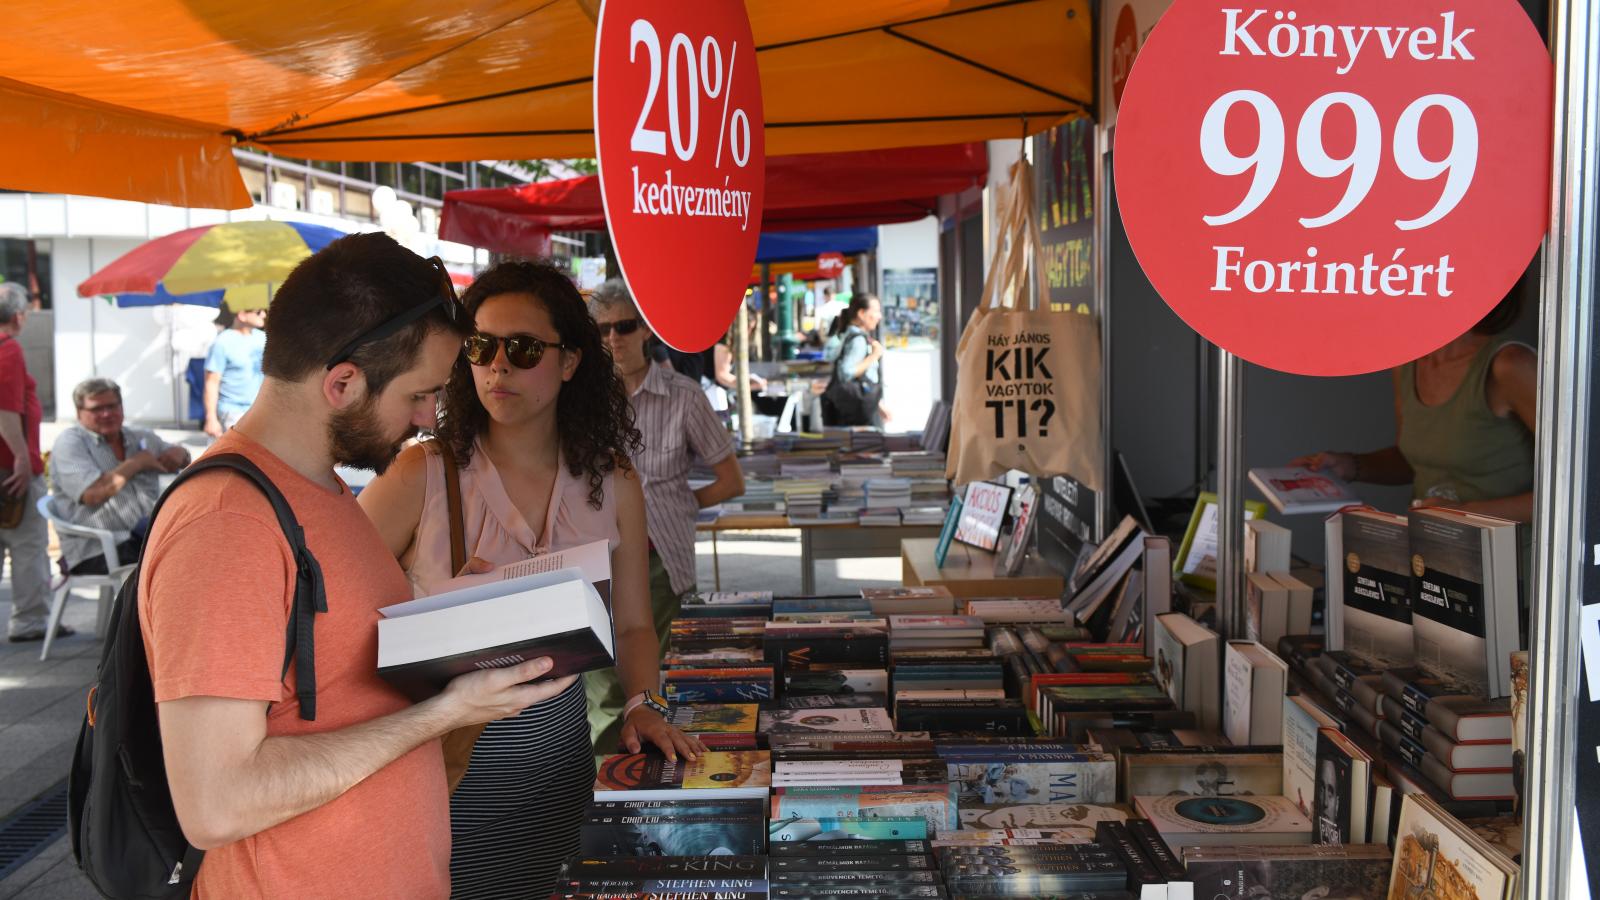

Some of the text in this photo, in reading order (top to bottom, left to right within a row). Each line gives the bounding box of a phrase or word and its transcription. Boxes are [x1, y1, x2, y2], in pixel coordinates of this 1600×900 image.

[1219, 8, 1475, 75] Könyvek
[630, 18, 752, 169] 20%
[1199, 89, 1479, 231] 999
[631, 166, 752, 231] kedvezmény
[1210, 245, 1455, 298] Forintért
[987, 330, 1051, 347] HÁY JÁNOS
[985, 347, 1053, 381] KIK
[986, 382, 1054, 397] VAGYTOK
[985, 399, 1055, 439] TI?
[656, 879, 717, 889] STEPHEN
[720, 879, 754, 888] KING
[684, 860, 755, 872] KING
[649, 891, 709, 900] STEPHEN
[714, 891, 746, 900] KING
